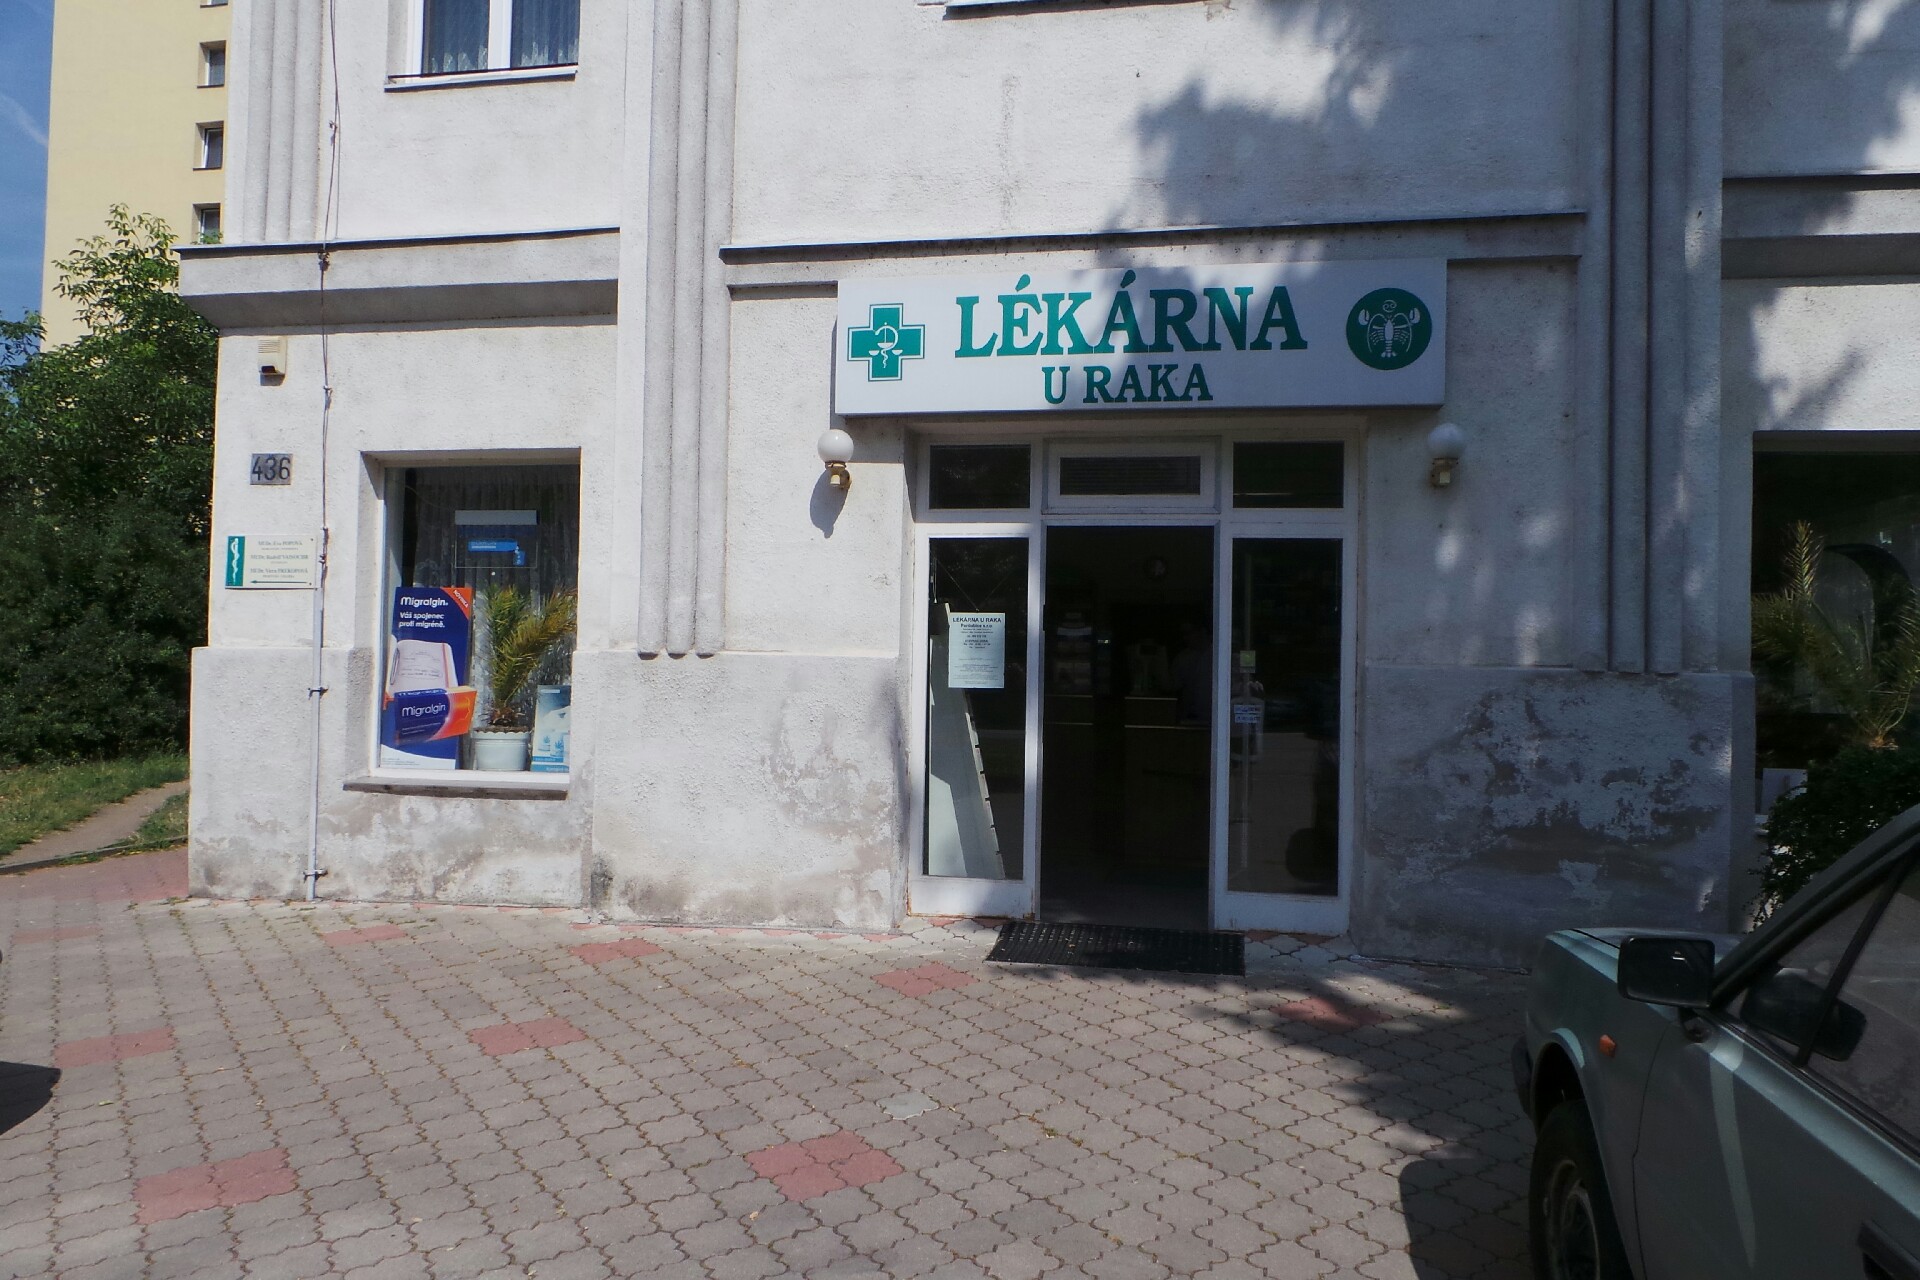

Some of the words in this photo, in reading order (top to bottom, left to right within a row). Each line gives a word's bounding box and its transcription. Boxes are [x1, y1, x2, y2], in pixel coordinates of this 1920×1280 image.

[954, 269, 1308, 359] LÉKÁRNA
[1041, 366, 1071, 405] U
[1083, 362, 1214, 405] RAKA
[252, 456, 291, 481] 436
[398, 620, 414, 628] proti
[399, 611, 412, 619] Váš
[413, 612, 445, 620] spojenec
[402, 703, 446, 717] Migralgin
